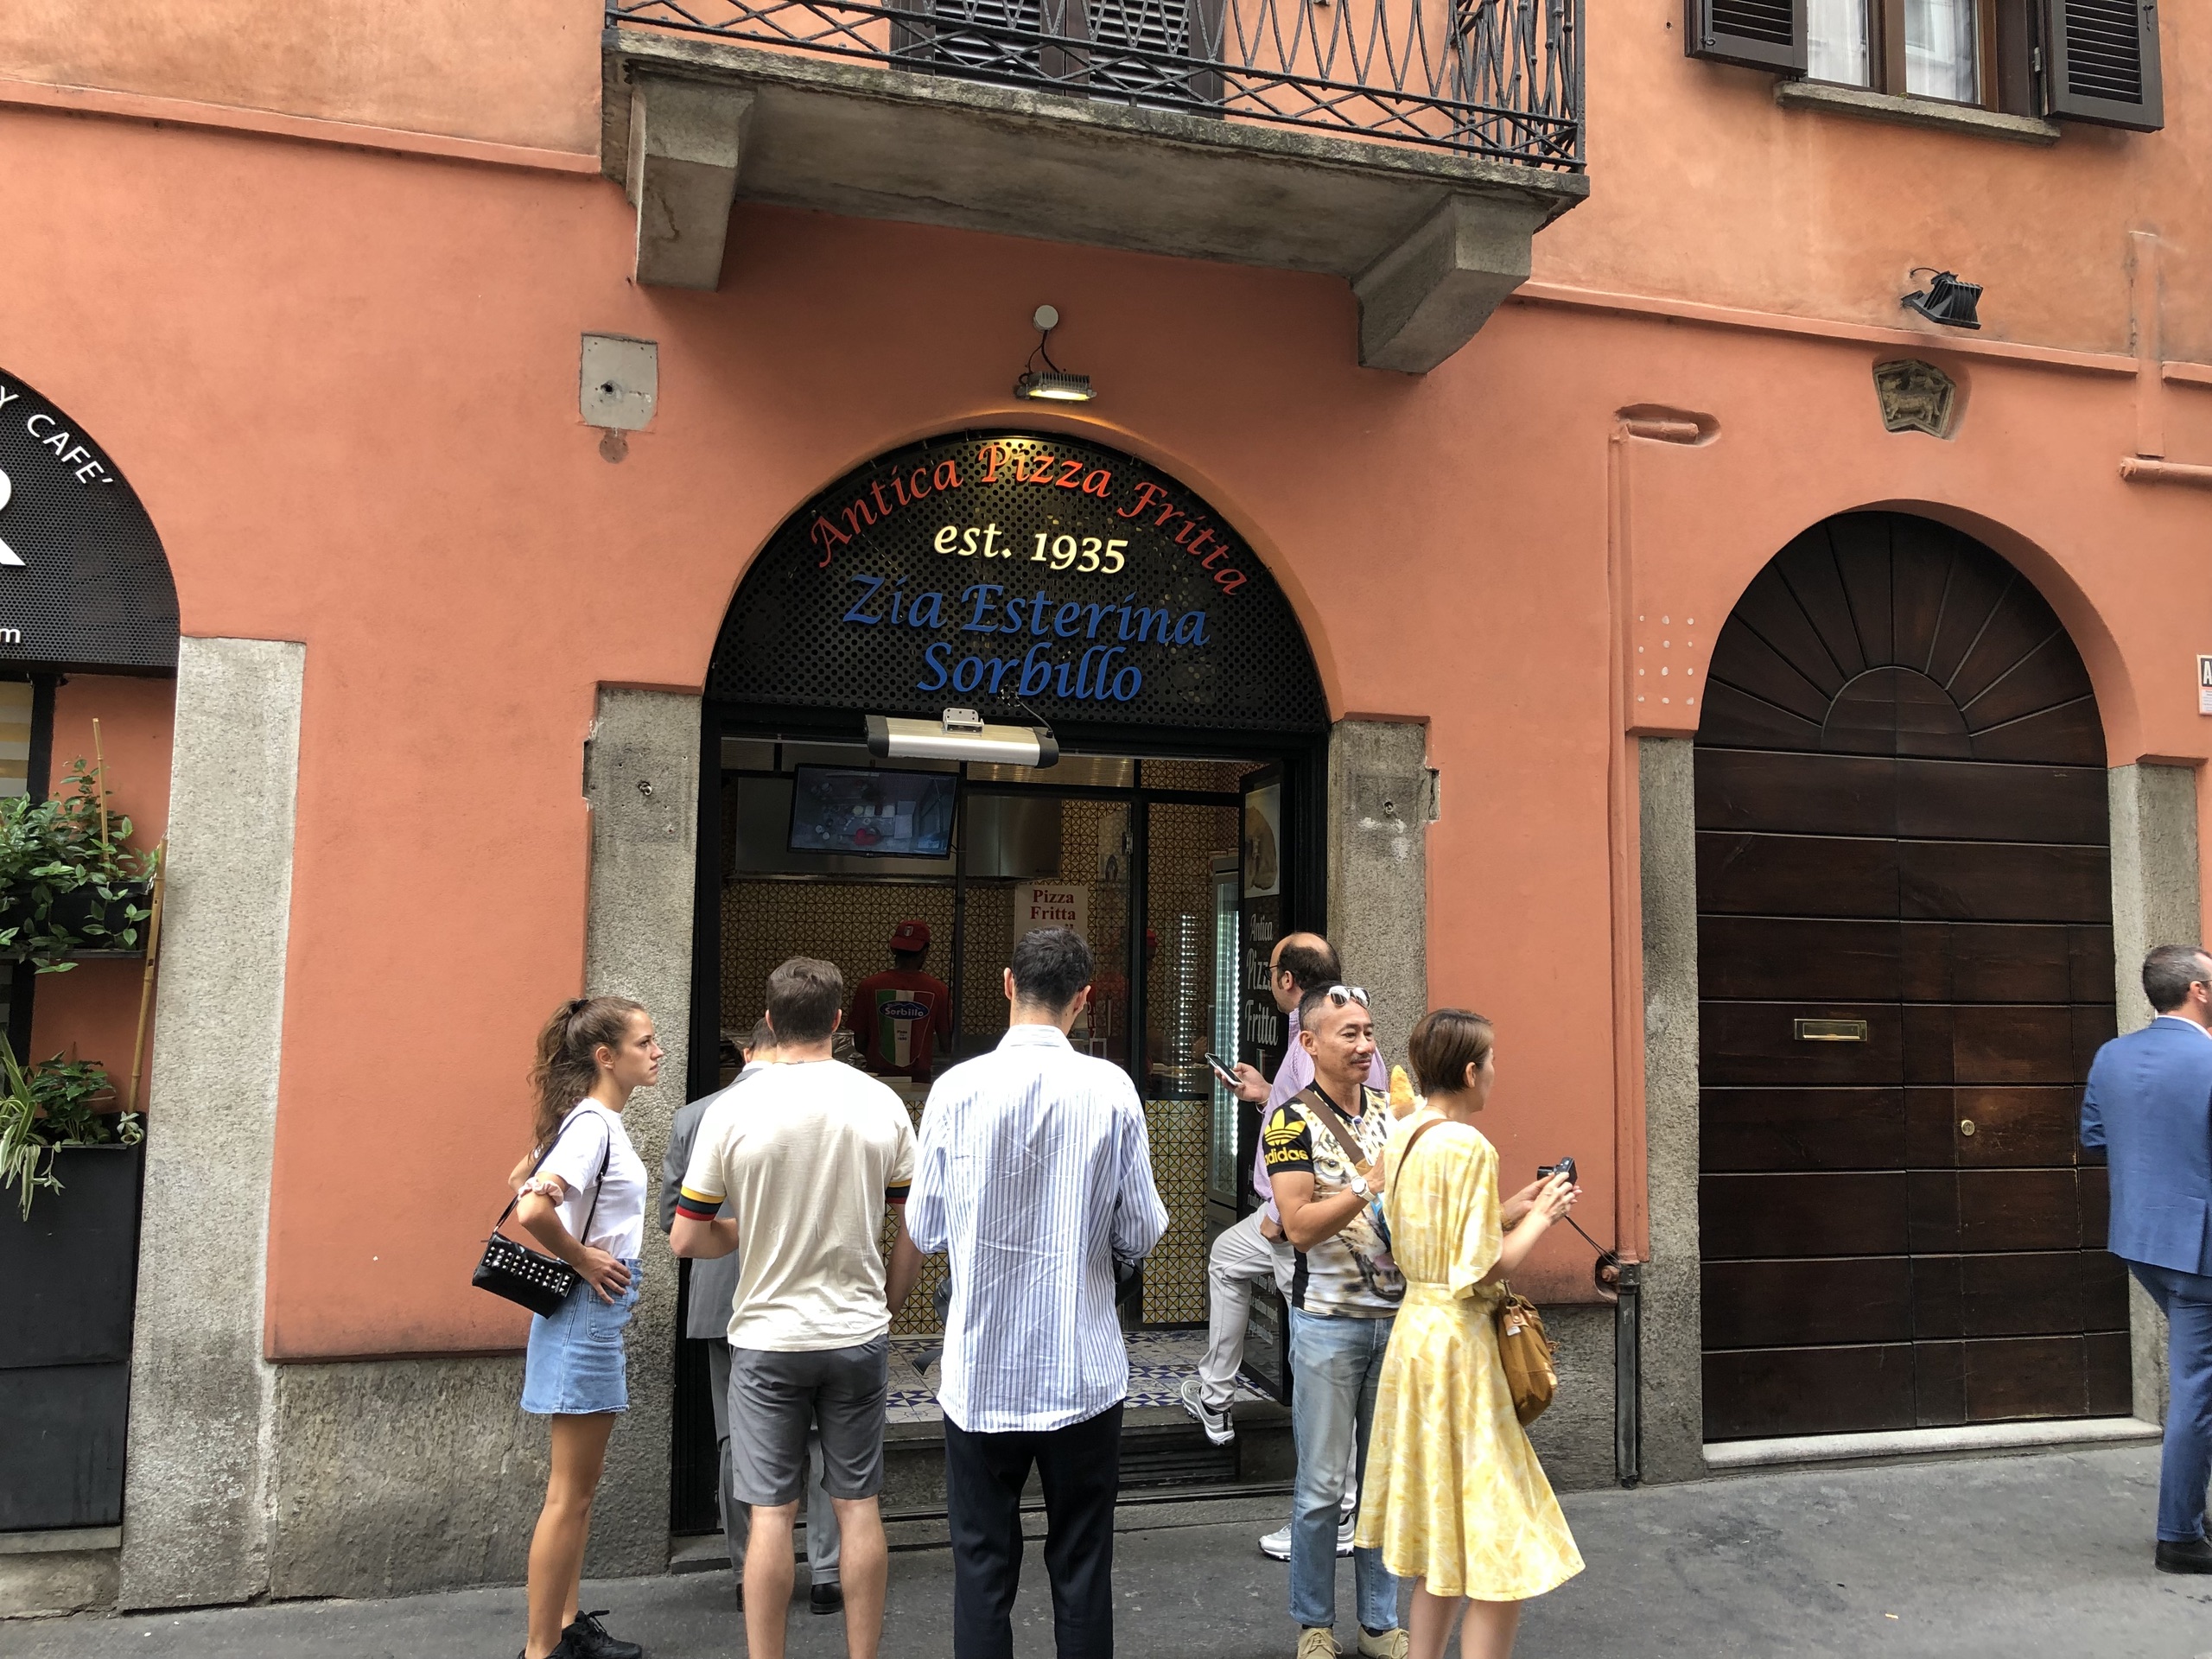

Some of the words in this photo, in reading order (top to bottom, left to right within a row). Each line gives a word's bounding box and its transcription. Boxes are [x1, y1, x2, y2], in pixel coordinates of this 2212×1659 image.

[810, 464, 964, 569] Antica
[978, 443, 1113, 498] Pizza
[1116, 481, 1248, 596] Fritta
[933, 522, 1012, 560] est.
[1030, 531, 1129, 575] 1935
[842, 574, 948, 630] Zia
[959, 582, 1211, 646] Esterina
[916, 640, 1143, 702] Sorbillo
[1030, 906, 1077, 920] Fritta
[1033, 889, 1075, 904] Pizza
[1249, 913, 1274, 942] Antica
[1246, 948, 1273, 991] Pizz
[884, 1007, 925, 1017] Sorbillo
[1244, 1000, 1279, 1047] Fritta
